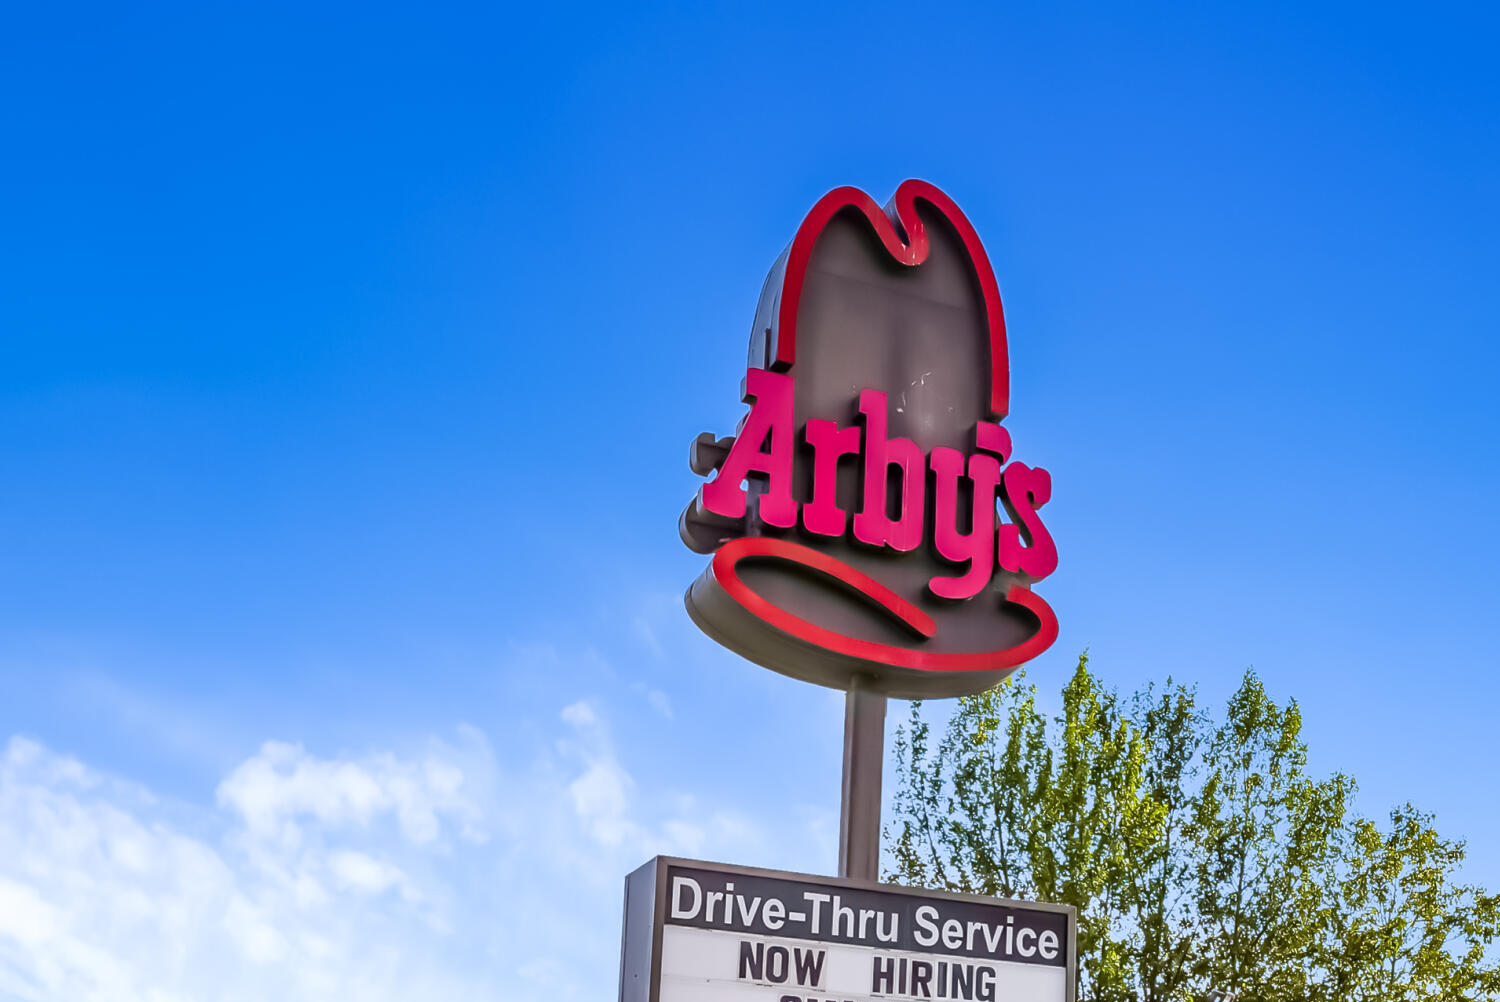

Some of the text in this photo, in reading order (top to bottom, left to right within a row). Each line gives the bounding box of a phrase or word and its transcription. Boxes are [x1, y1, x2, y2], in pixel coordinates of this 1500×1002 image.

[703, 368, 1058, 599] Arby's
[671, 876, 1060, 960] Drive-Thru Service
[739, 941, 997, 1002] NOW HIRING
